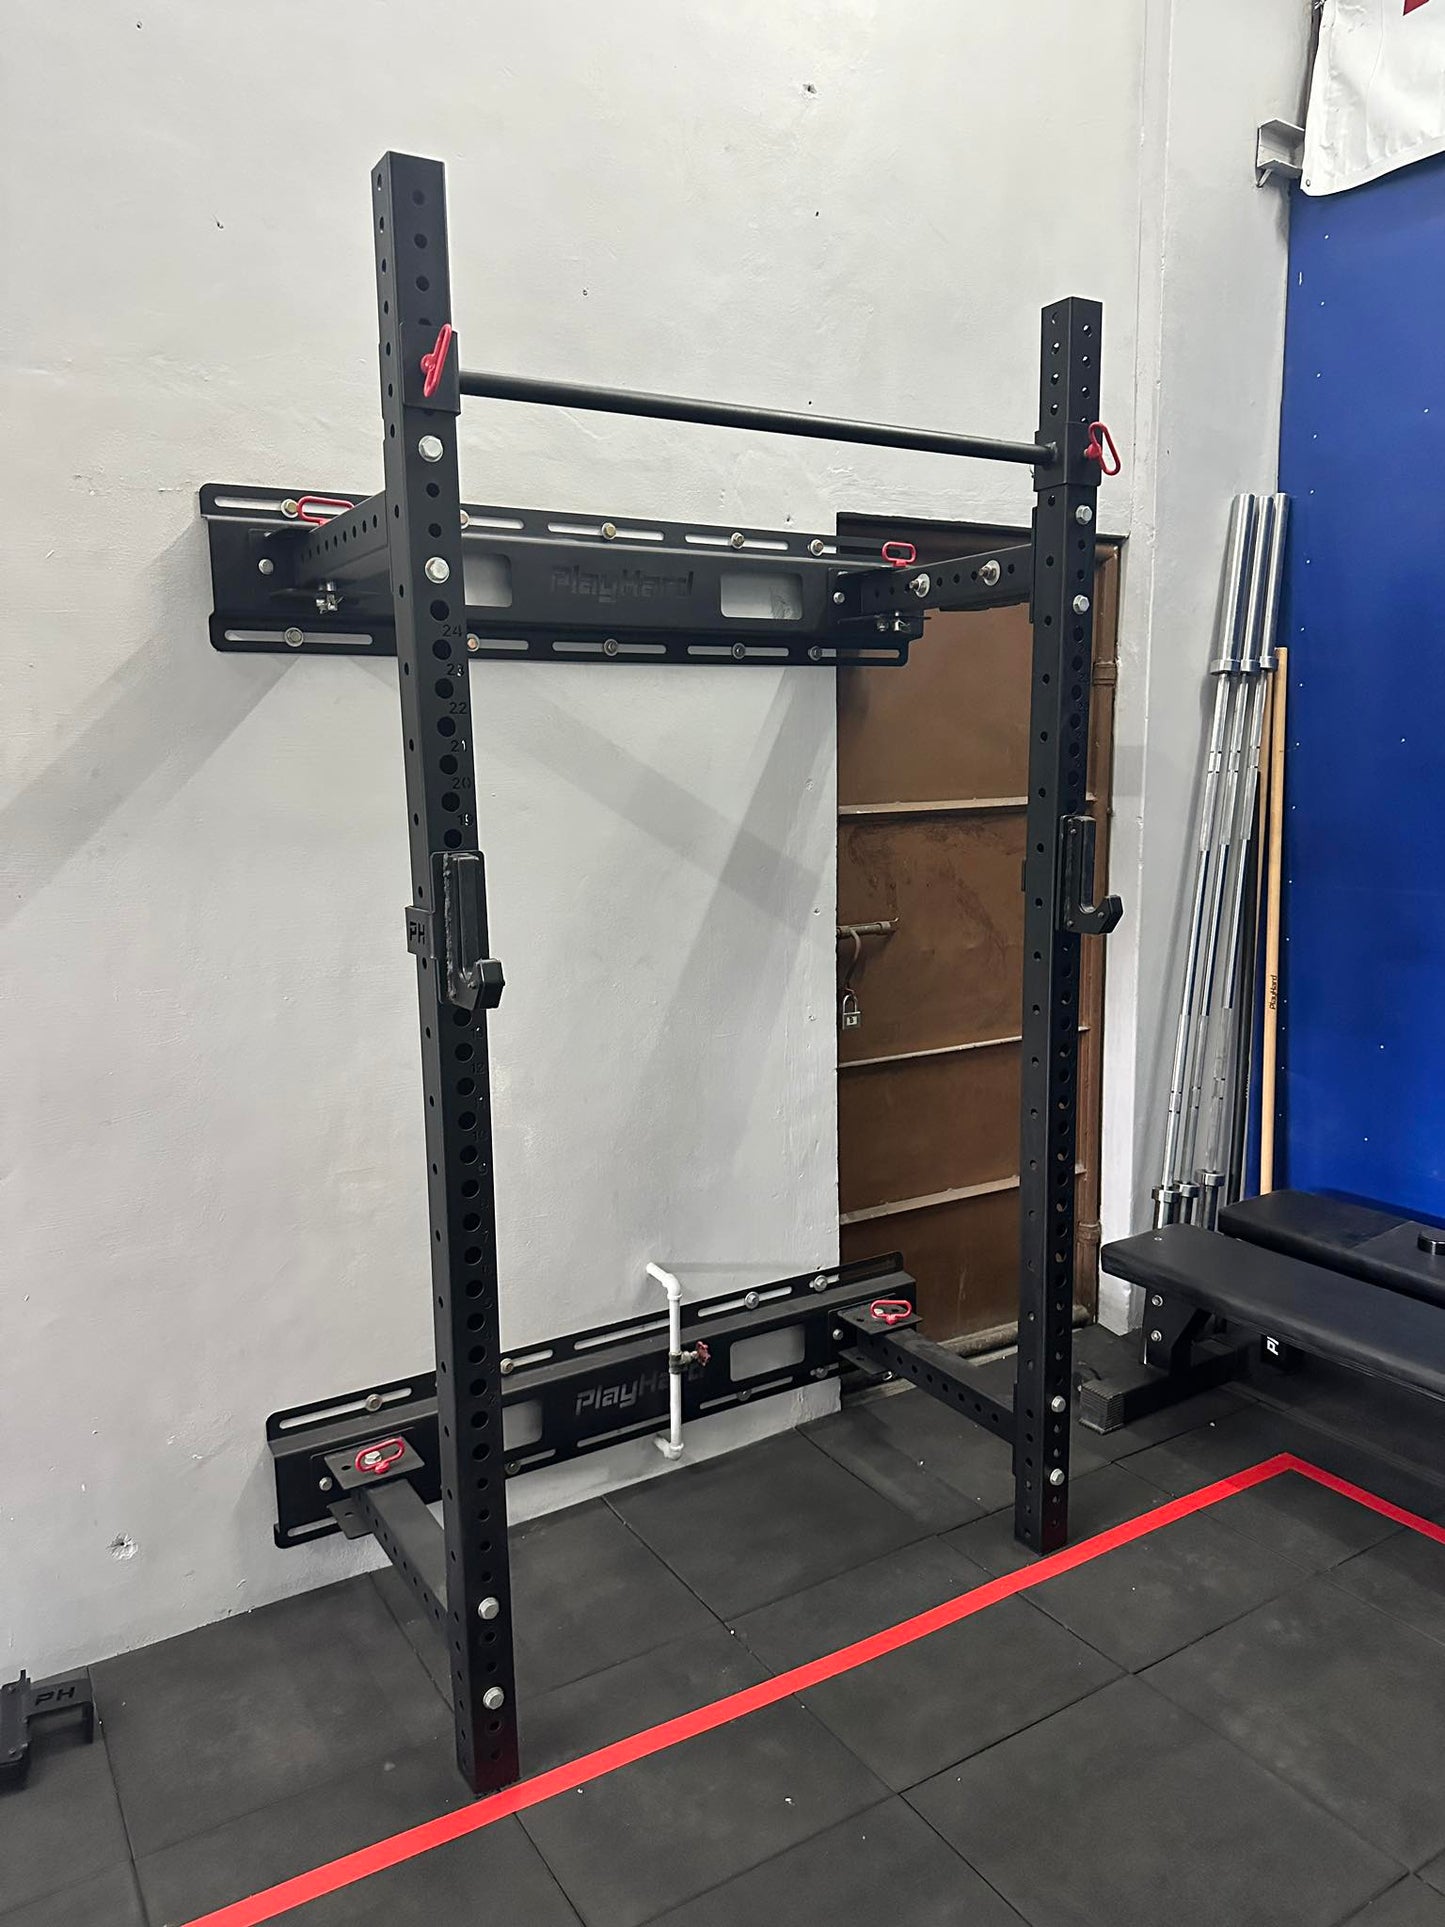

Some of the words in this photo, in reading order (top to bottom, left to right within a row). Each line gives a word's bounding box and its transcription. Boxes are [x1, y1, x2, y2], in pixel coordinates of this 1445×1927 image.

[551, 564, 694, 602] PlayHard
[442, 624, 462, 637] 24
[446, 663, 465, 677] 23
[449, 701, 468, 714] 22
[450, 739, 467, 752] 21
[452, 776, 471, 789] 20
[409, 920, 425, 945] PH
[35, 1686, 75, 1706] PH
